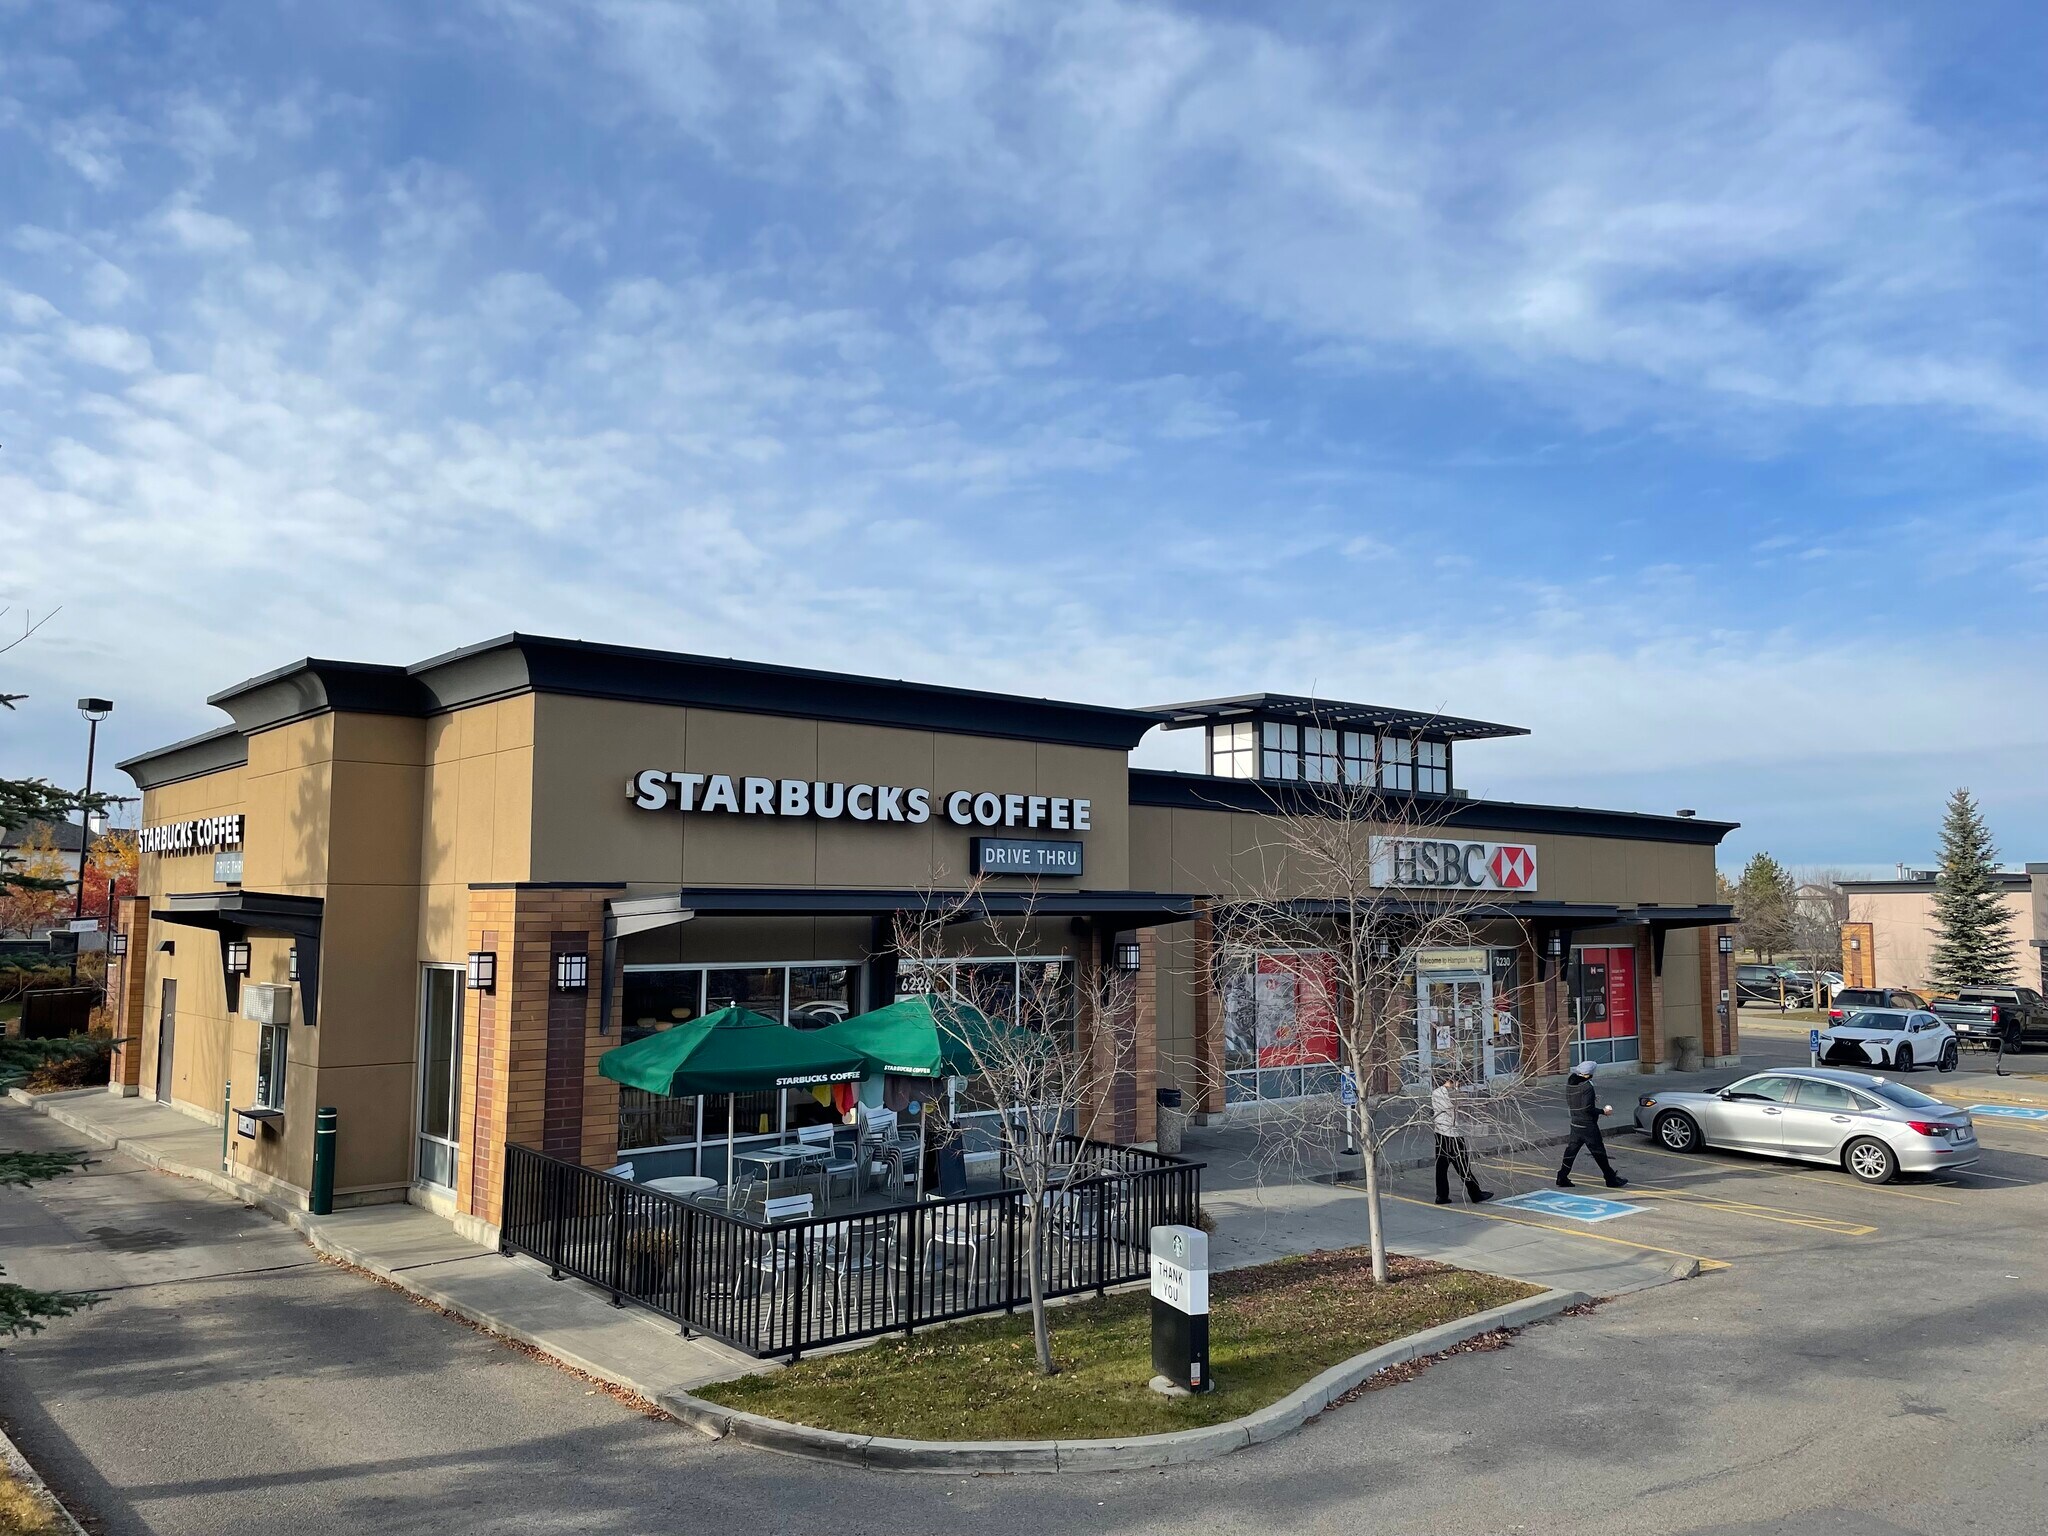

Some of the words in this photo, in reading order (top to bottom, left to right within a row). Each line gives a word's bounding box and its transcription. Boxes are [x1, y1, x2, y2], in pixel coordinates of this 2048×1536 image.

[634, 769, 931, 824] STARBUCKS
[946, 790, 1091, 831] COFFEE
[138, 820, 193, 854] STARBUCKS
[197, 814, 240, 846] COFFEE
[984, 847, 1032, 865] DRIVE
[1036, 850, 1078, 867] THRU
[1385, 840, 1487, 888] HSBC
[216, 861, 230, 874] DRIVE
[901, 976, 931, 992] 6226
[776, 1073, 827, 1086] STARBUCKS
[830, 1071, 861, 1081] COFFEE
[883, 1064, 913, 1073] STARBUCKS
[912, 1066, 931, 1074] COFFEE
[1158, 1261, 1184, 1287] THANK
[1163, 1282, 1179, 1302] YOU
